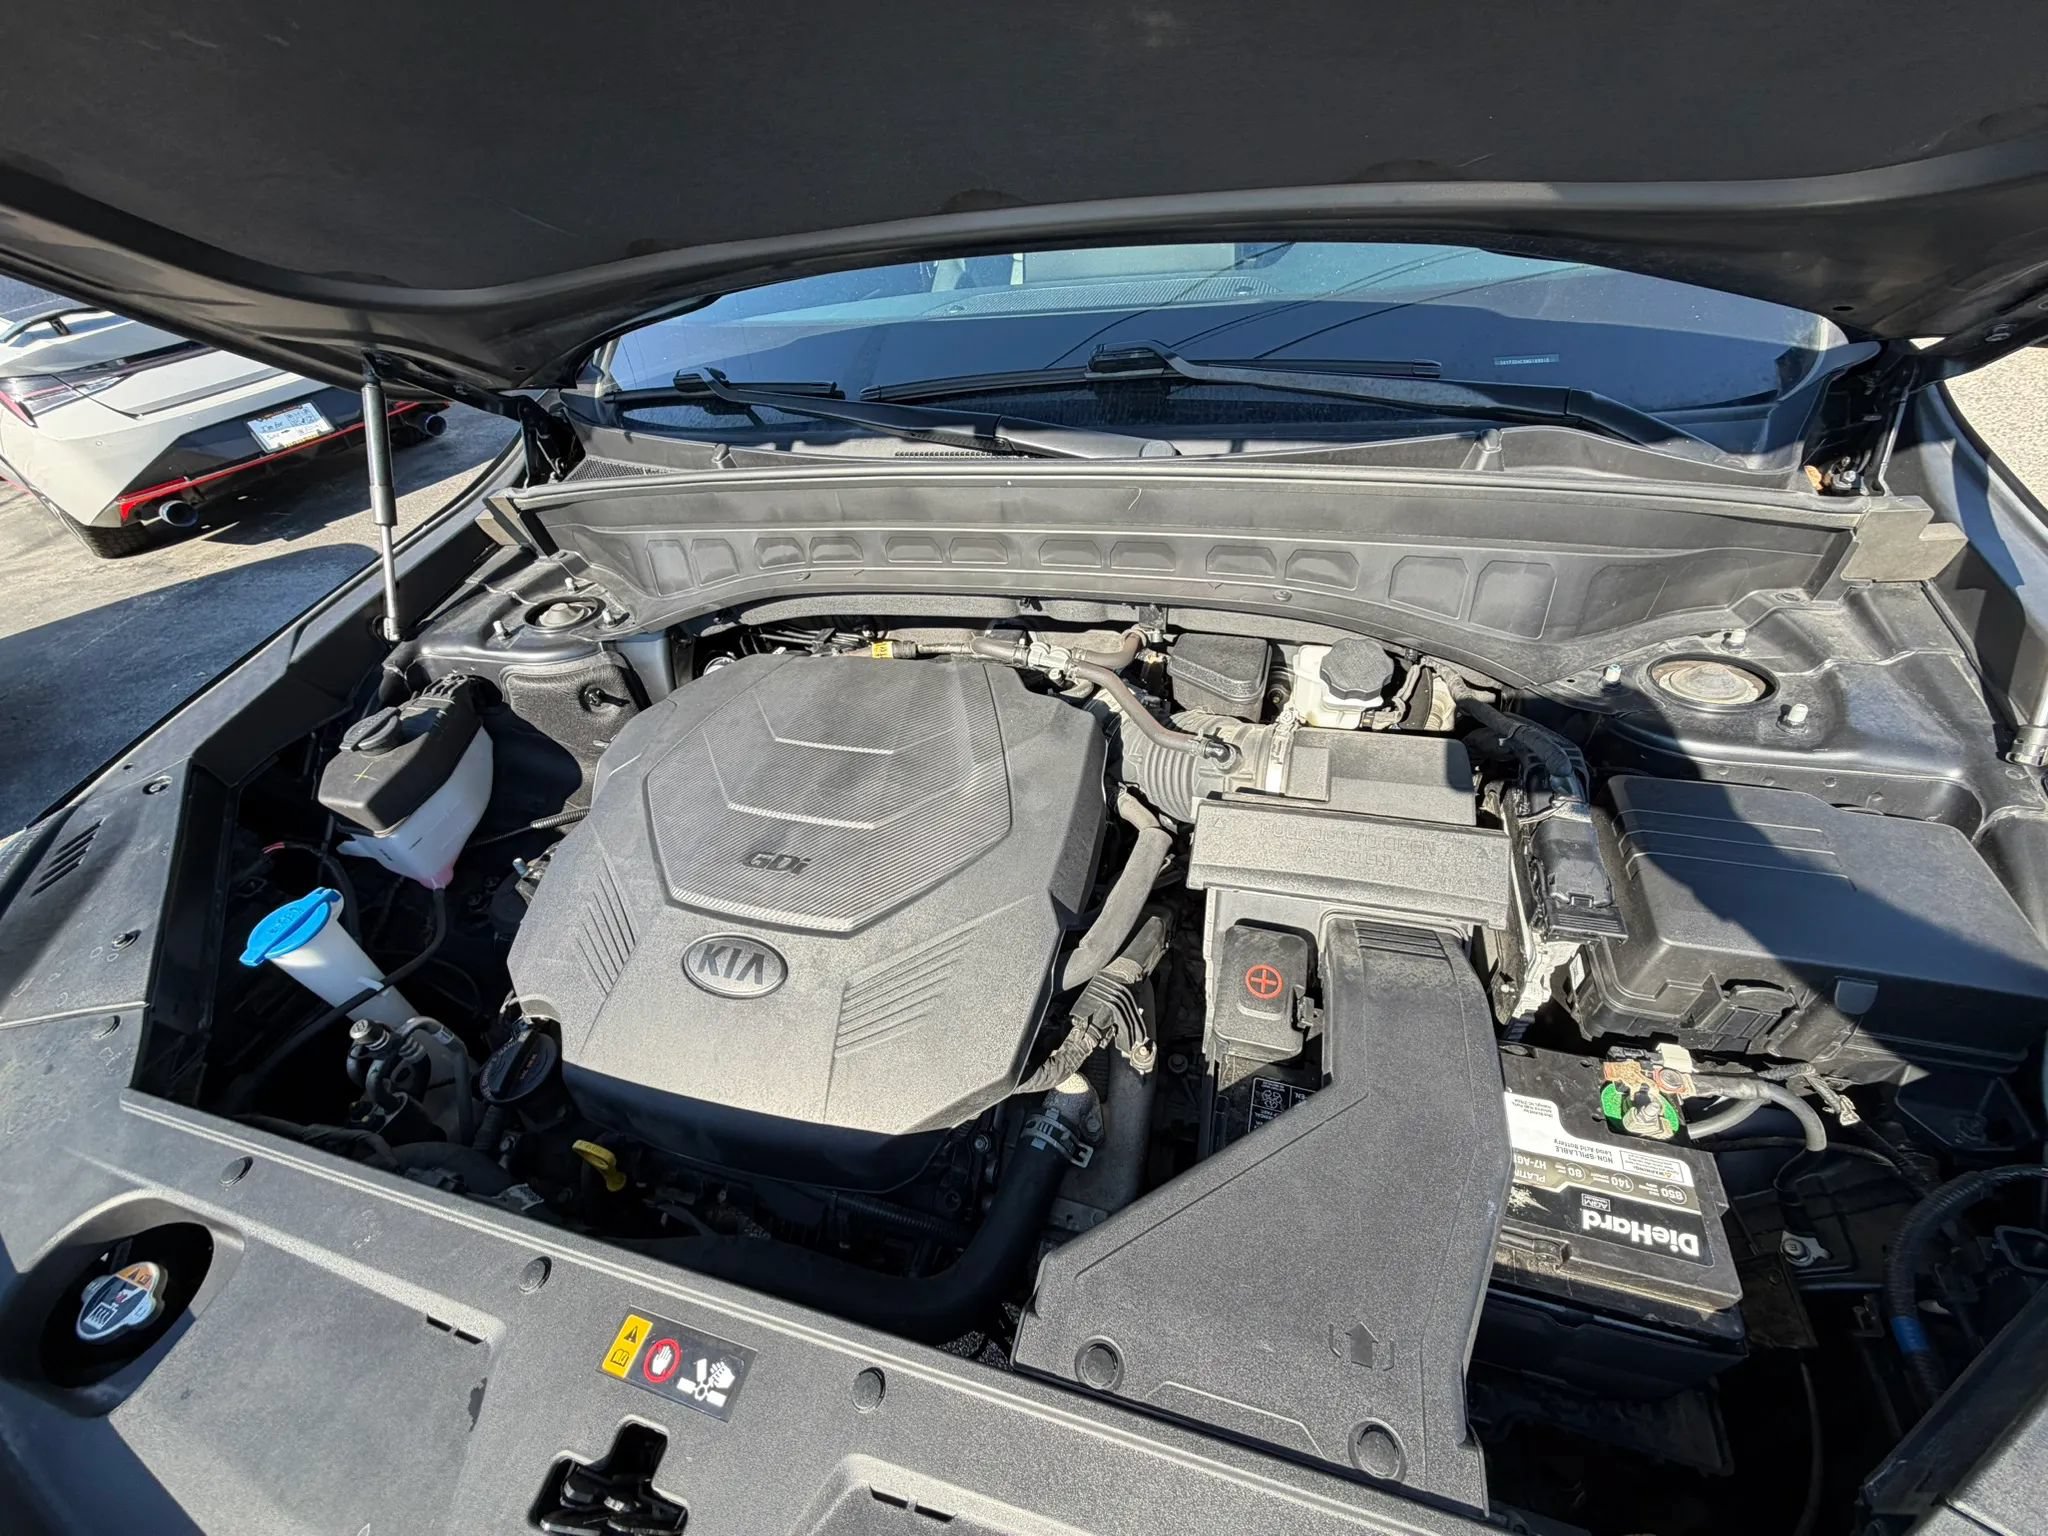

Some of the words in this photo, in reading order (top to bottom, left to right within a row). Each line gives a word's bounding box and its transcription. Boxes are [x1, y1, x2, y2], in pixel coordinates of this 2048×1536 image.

[1260, 823, 1305, 840] PULL
[1382, 836, 1435, 854] OPEN
[741, 850, 812, 876] GDi
[697, 943, 765, 985] KIA
[1553, 1138, 1579, 1149] Battery
[1580, 1144, 1594, 1153] Acid
[1595, 1148, 1612, 1157] Lead
[1514, 1168, 1546, 1183] PLATIN
[1567, 1167, 1583, 1178] 80
[1610, 1176, 1631, 1189] 140
[1660, 1187, 1684, 1201] 850
[1584, 1199, 1608, 1210] AGM
[1582, 1209, 1700, 1257] DieHard
